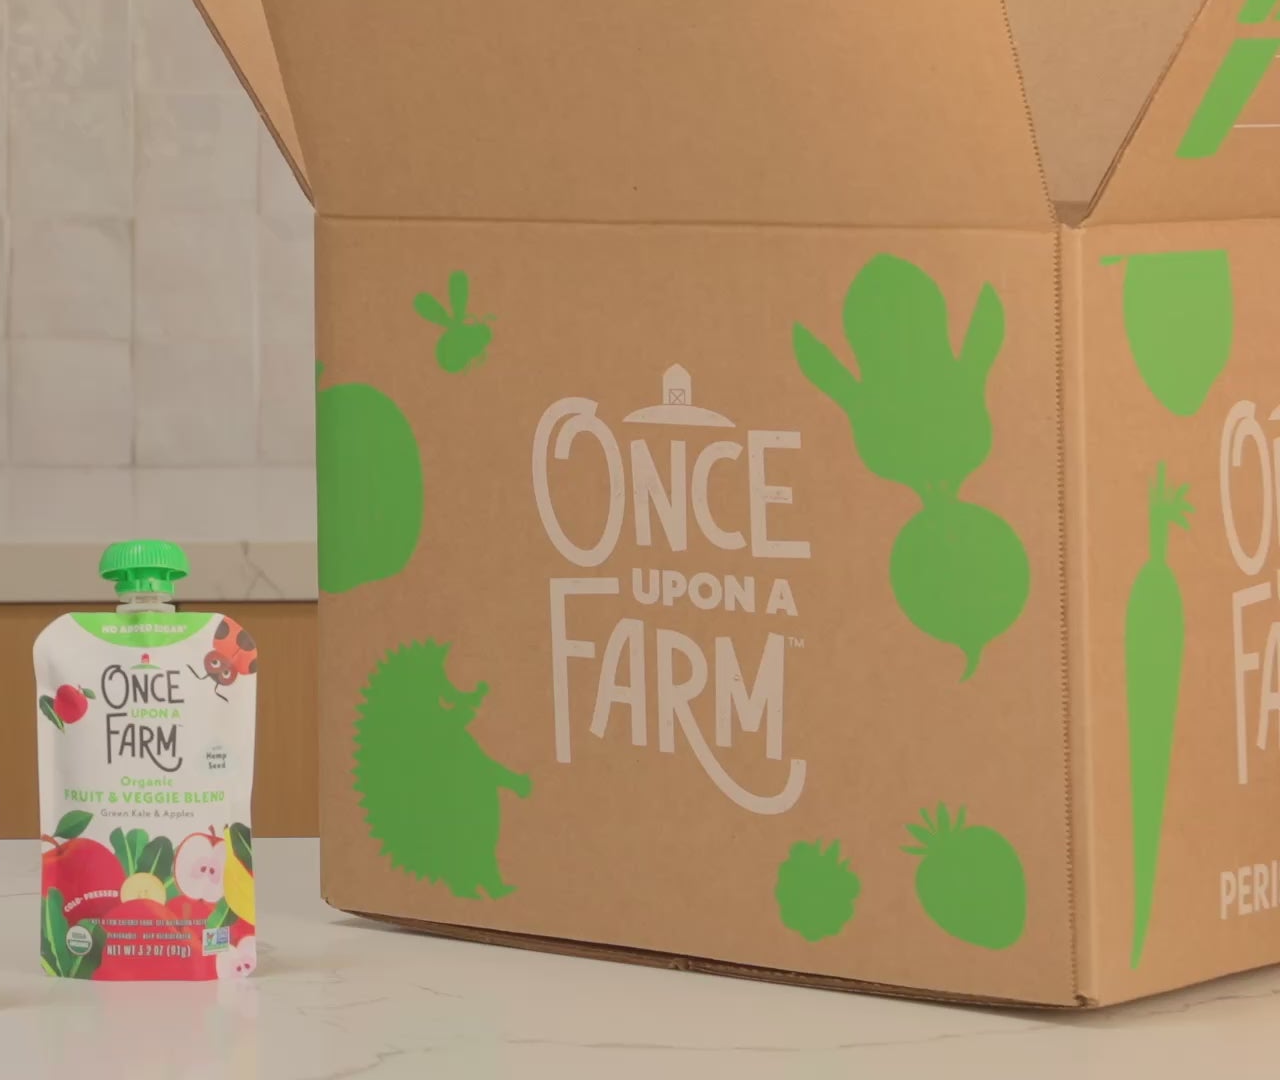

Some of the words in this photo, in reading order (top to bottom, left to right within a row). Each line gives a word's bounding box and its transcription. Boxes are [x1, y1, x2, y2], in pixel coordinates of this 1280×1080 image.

[532, 396, 811, 568] ONCE
[632, 566, 754, 613] UPON
[765, 578, 799, 617] A
[101, 625, 119, 634] NO
[120, 624, 153, 634] ADDED
[101, 664, 184, 710] ONCE
[131, 708, 168, 719] UPON
[172, 708, 182, 719] A
[206, 752, 227, 762] Hemp
[208, 762, 226, 770] Seed
[121, 776, 173, 789] Organic
[64, 789, 104, 804] FRUIT
[108, 791, 120, 804] &
[123, 791, 179, 804] VEGGIE
[184, 790, 225, 804] BLEND
[100, 809, 129, 818] Green
[132, 809, 151, 818] Kale
[154, 809, 161, 818] &
[163, 809, 194, 820] Apples
[1220, 859, 1280, 921] PERI
